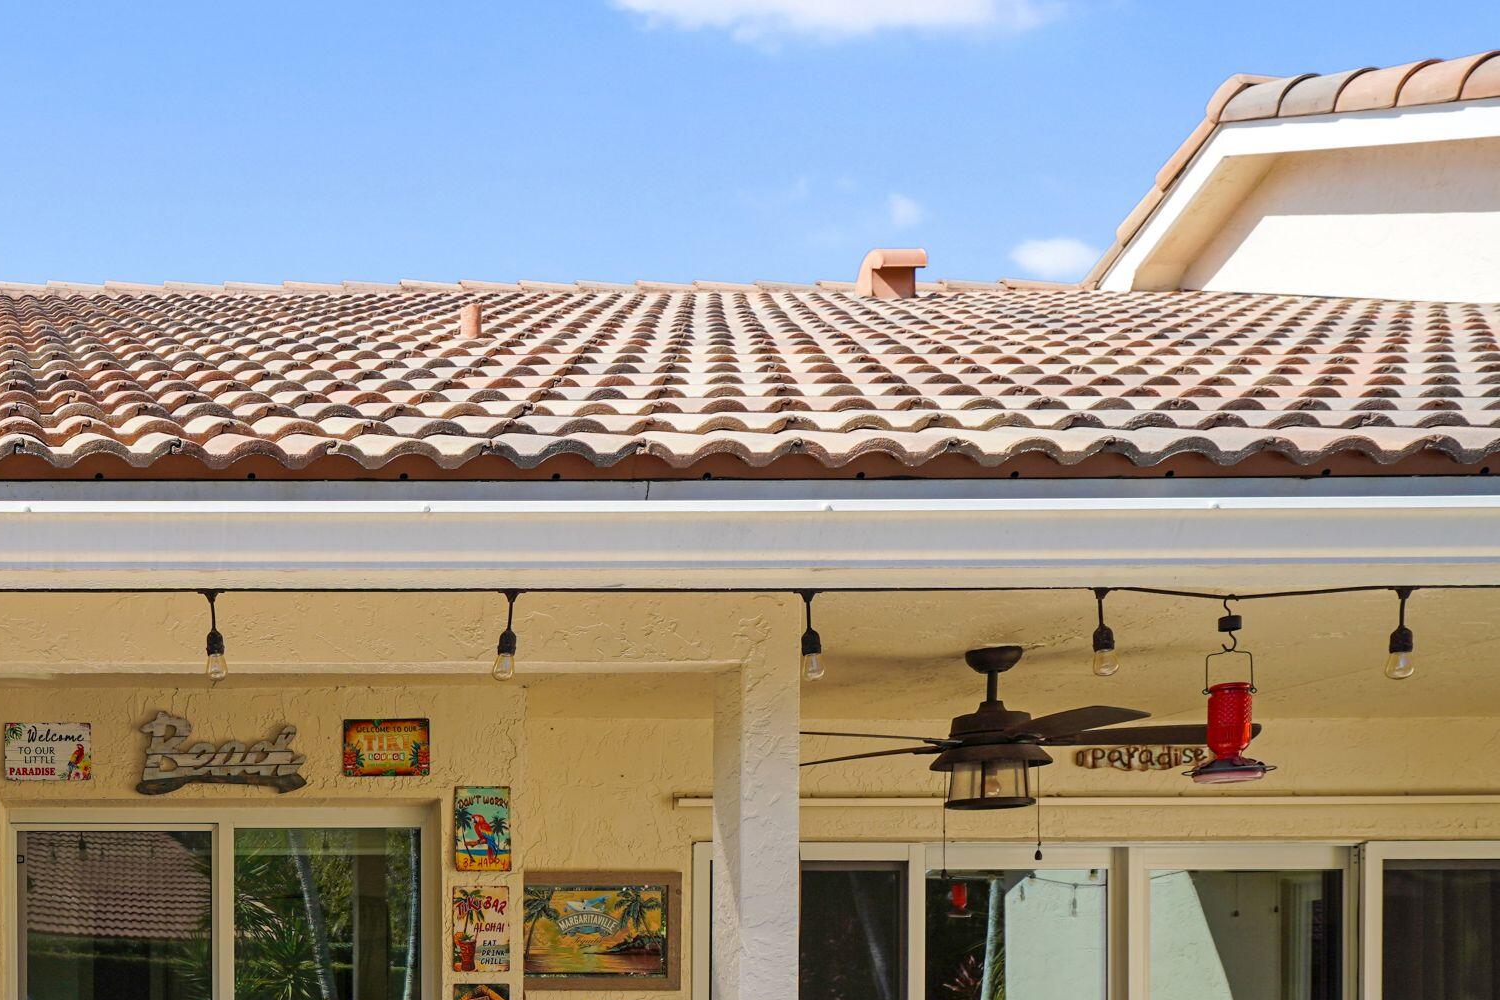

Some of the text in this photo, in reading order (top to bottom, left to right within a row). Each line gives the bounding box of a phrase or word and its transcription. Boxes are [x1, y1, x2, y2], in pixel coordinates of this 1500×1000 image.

[27, 725, 85, 743] Welcome
[356, 726, 391, 734] WELCOME
[403, 725, 418, 733] OUR
[364, 735, 410, 751] TIKI
[18, 746, 56, 755] TO OUR
[24, 756, 57, 764] LITTLE
[369, 752, 406, 761] LOUNGE
[9, 767, 56, 776] PARADISE
[457, 794, 509, 809] DON'T WORRY
[463, 857, 507, 869] BE HAPPY
[484, 896, 507, 915] BAR
[558, 913, 618, 932] MARGARITAVILLE
[481, 949, 505, 957] DRINK
[480, 957, 503, 965] CHILL
